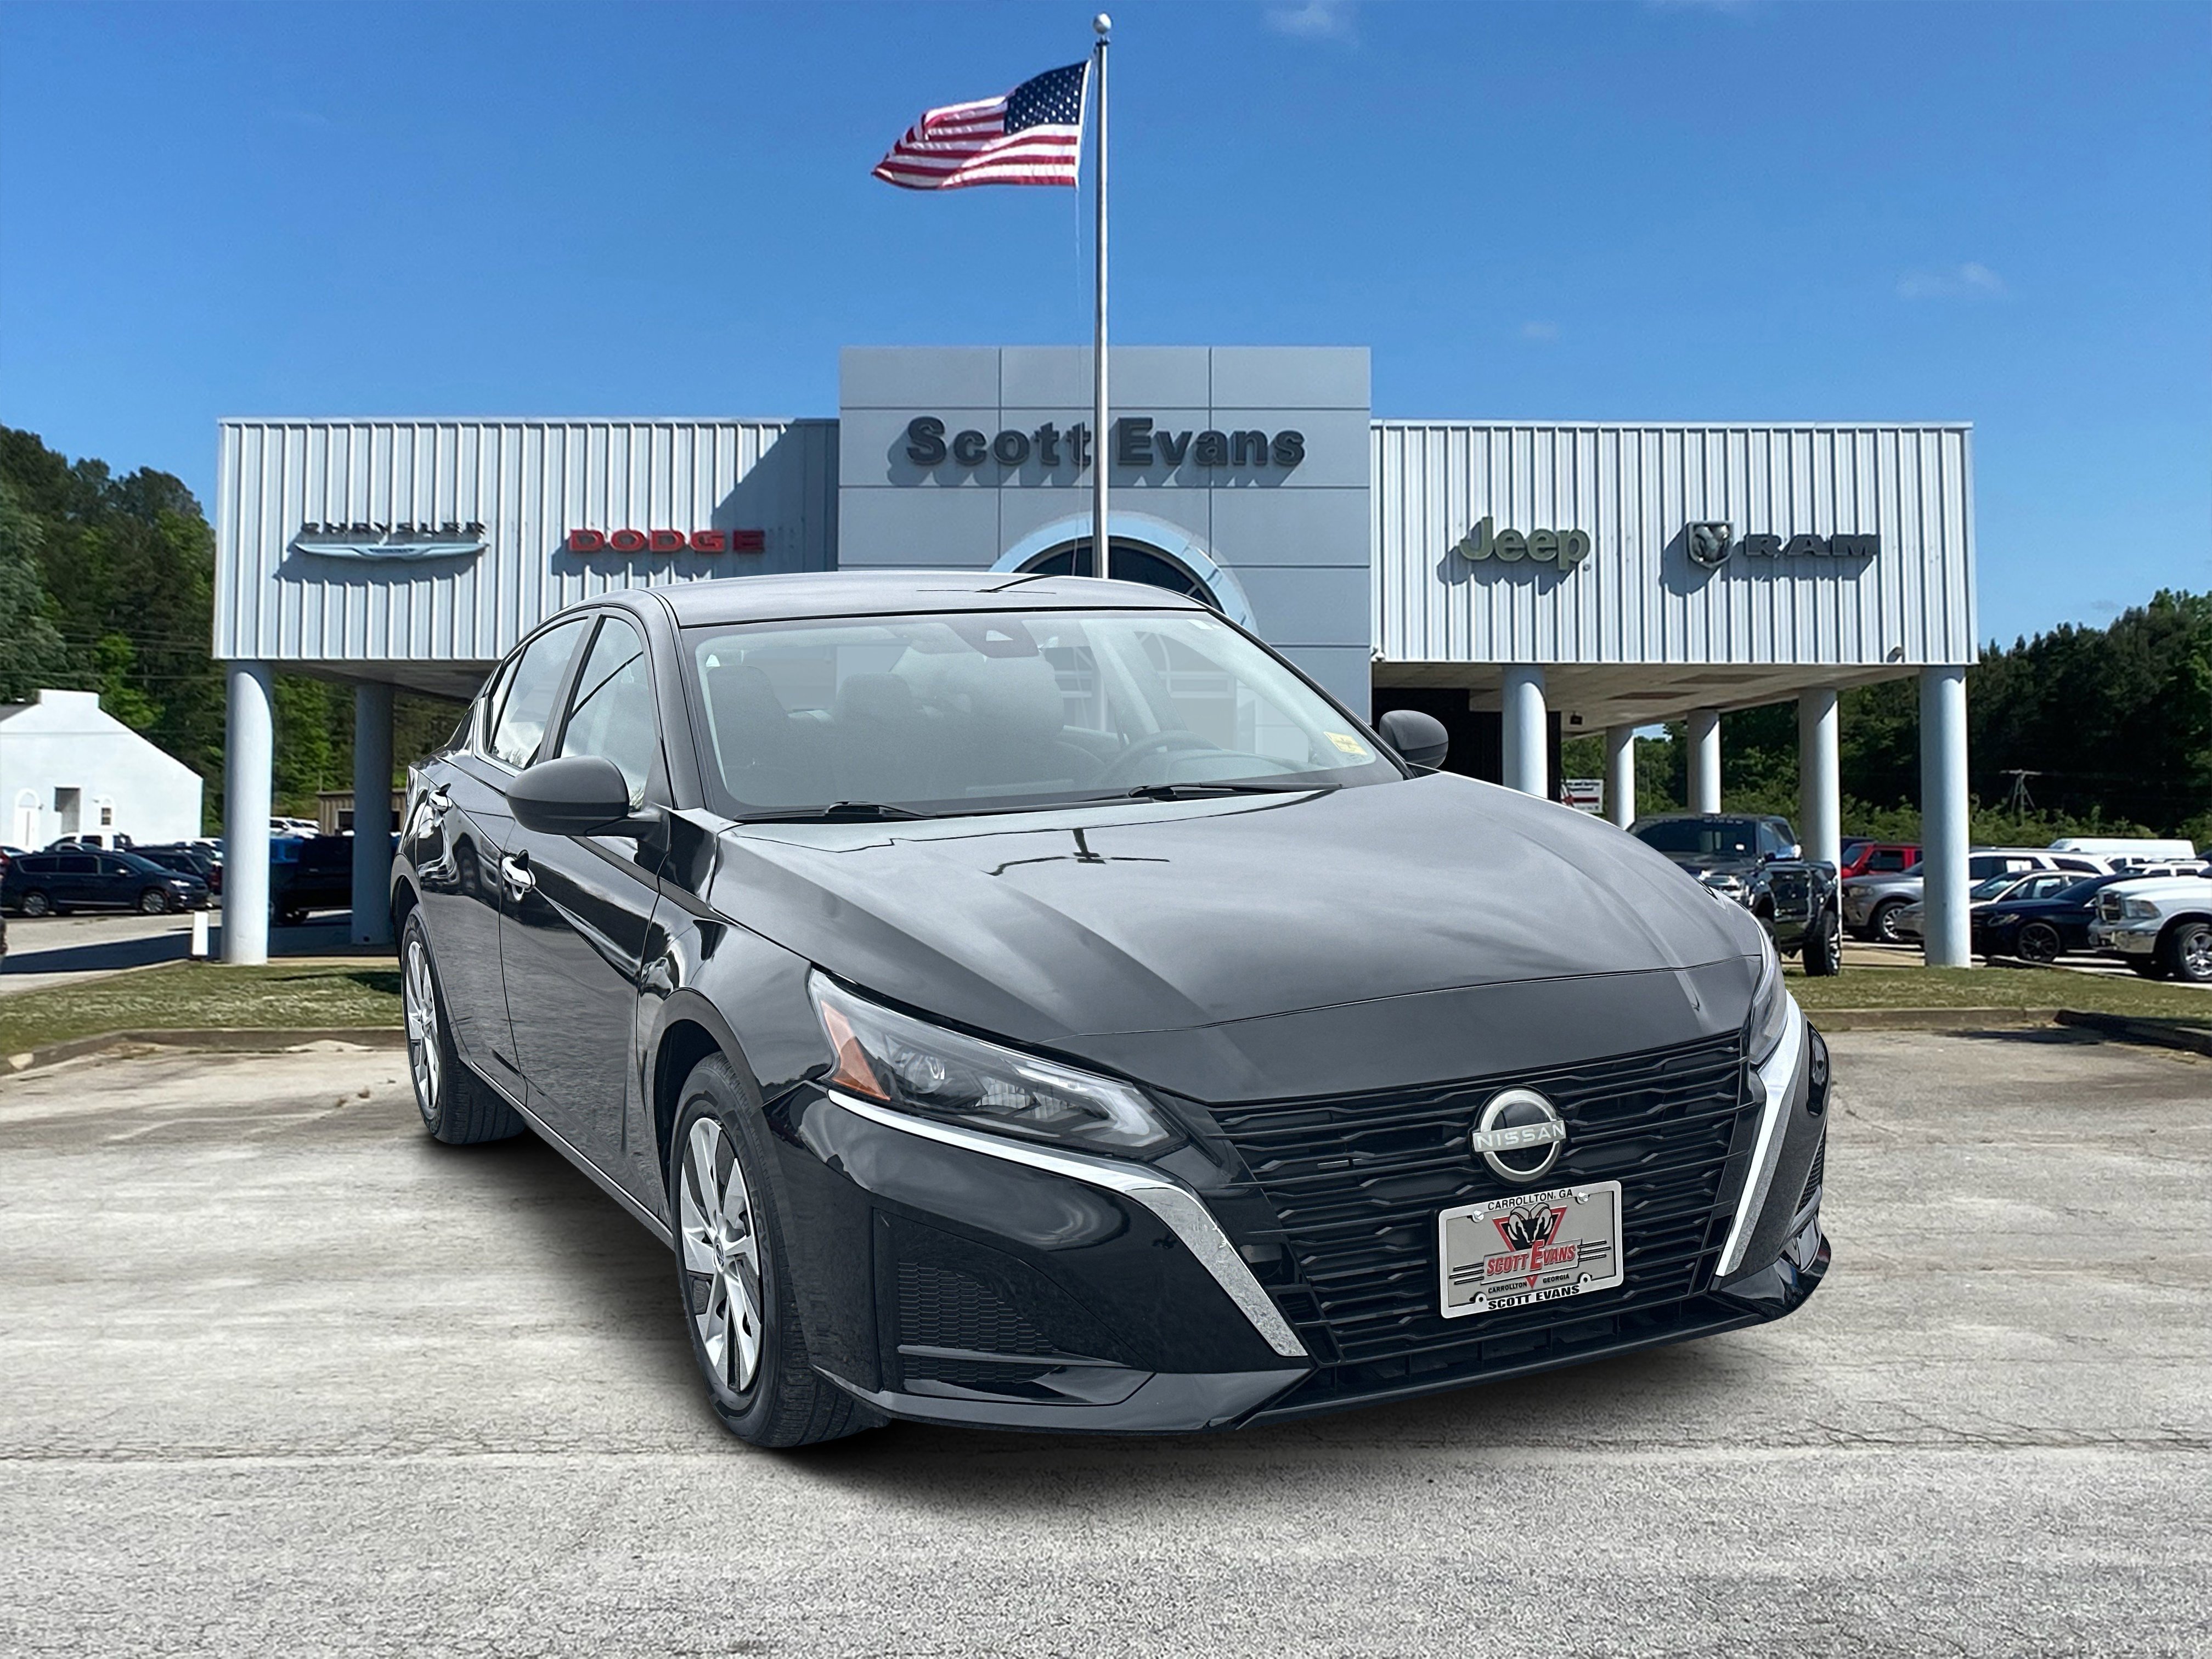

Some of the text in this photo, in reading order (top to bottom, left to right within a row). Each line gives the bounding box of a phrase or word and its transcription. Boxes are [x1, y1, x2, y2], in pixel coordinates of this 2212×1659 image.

[905, 415, 1306, 467] Scott Evans
[569, 529, 765, 552] DODGE
[1459, 516, 1591, 571] Jeep
[1745, 533, 1881, 557] RAM
[1476, 1122, 1565, 1149] NISSAN
[1487, 1188, 1573, 1211] CARROLLTON, GA
[1486, 1239, 1577, 1277] SCOTT EVANS
[1488, 1273, 1570, 1294] CARROLLTON GEORGIA
[1488, 1284, 1580, 1310] SCOTT EVANS
